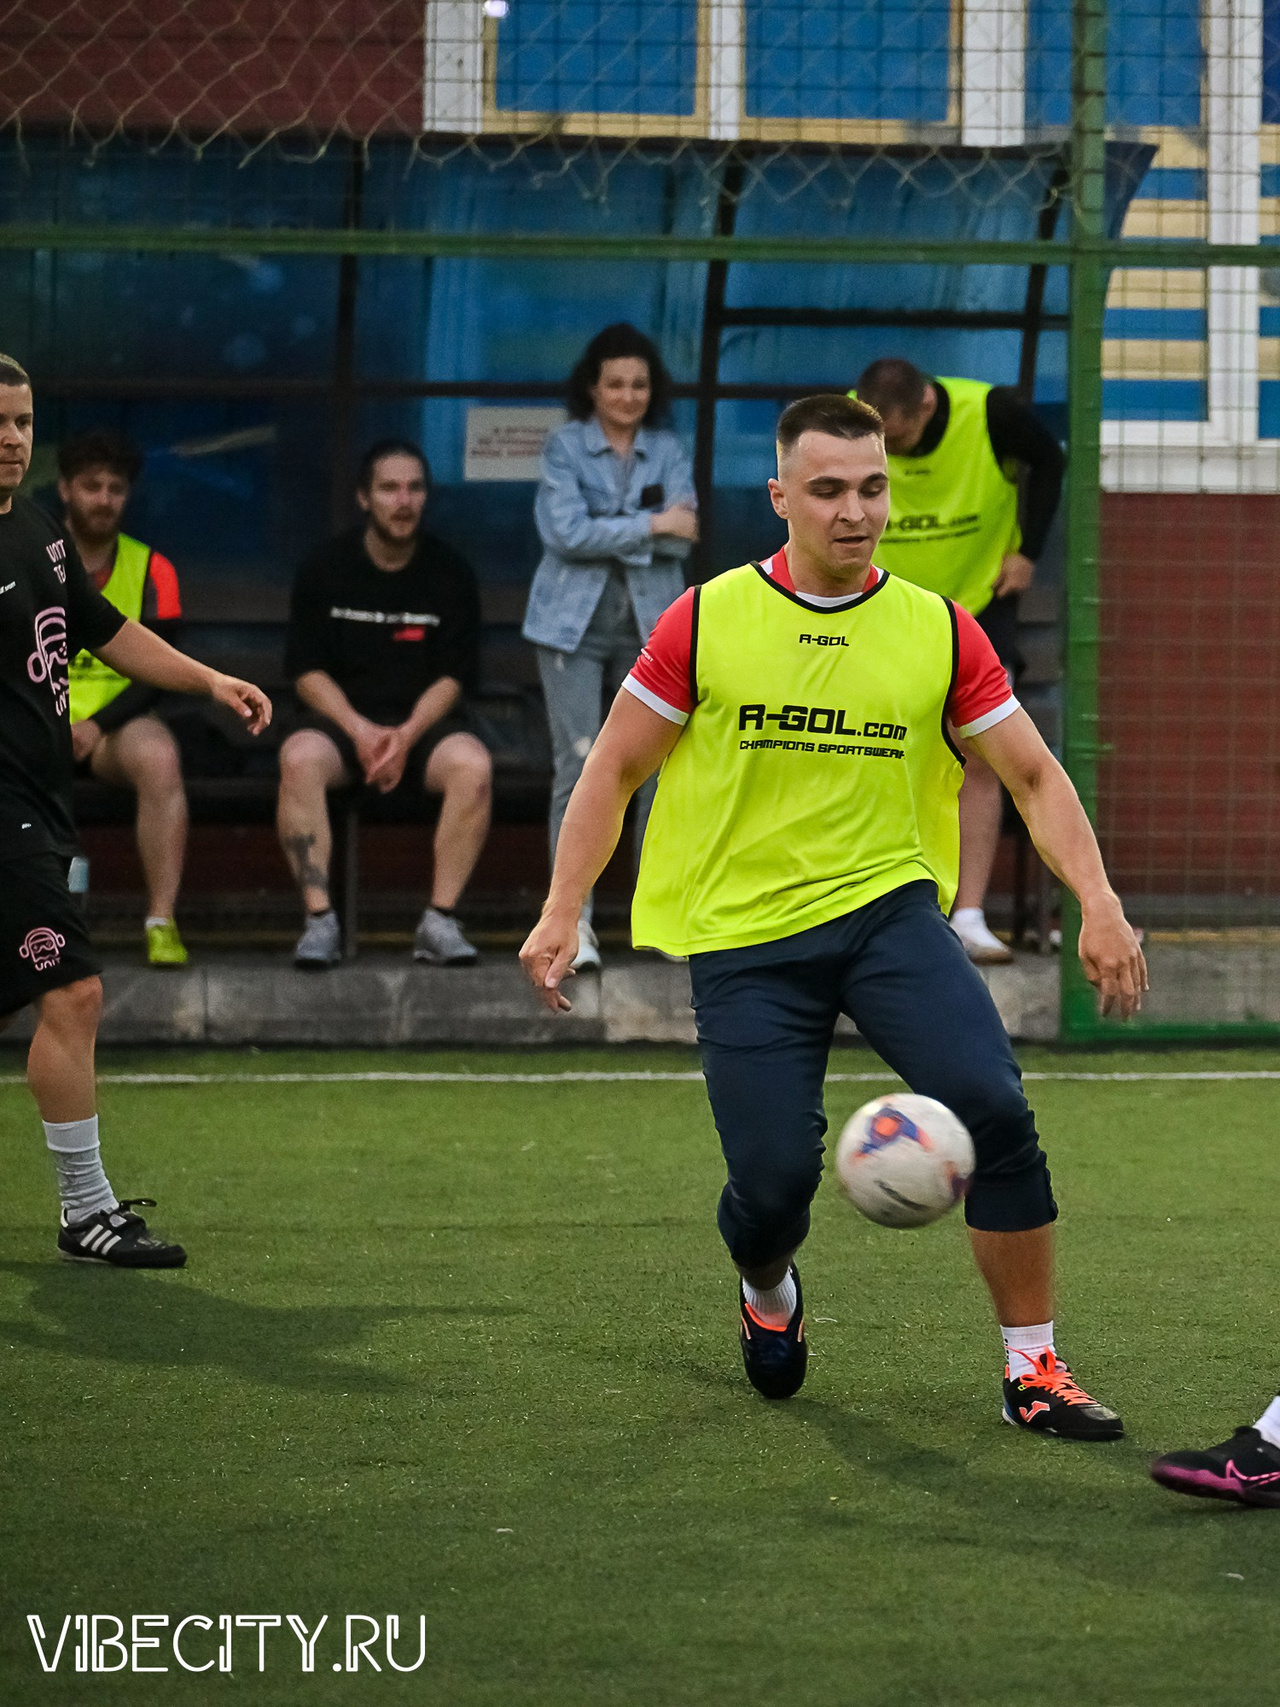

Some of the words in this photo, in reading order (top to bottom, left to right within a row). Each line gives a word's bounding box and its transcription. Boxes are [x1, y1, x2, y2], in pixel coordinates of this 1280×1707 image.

[798, 633, 850, 647] R-GOL
[739, 739, 815, 753] CHAMPIONS
[34, 957, 61, 972] UNIT
